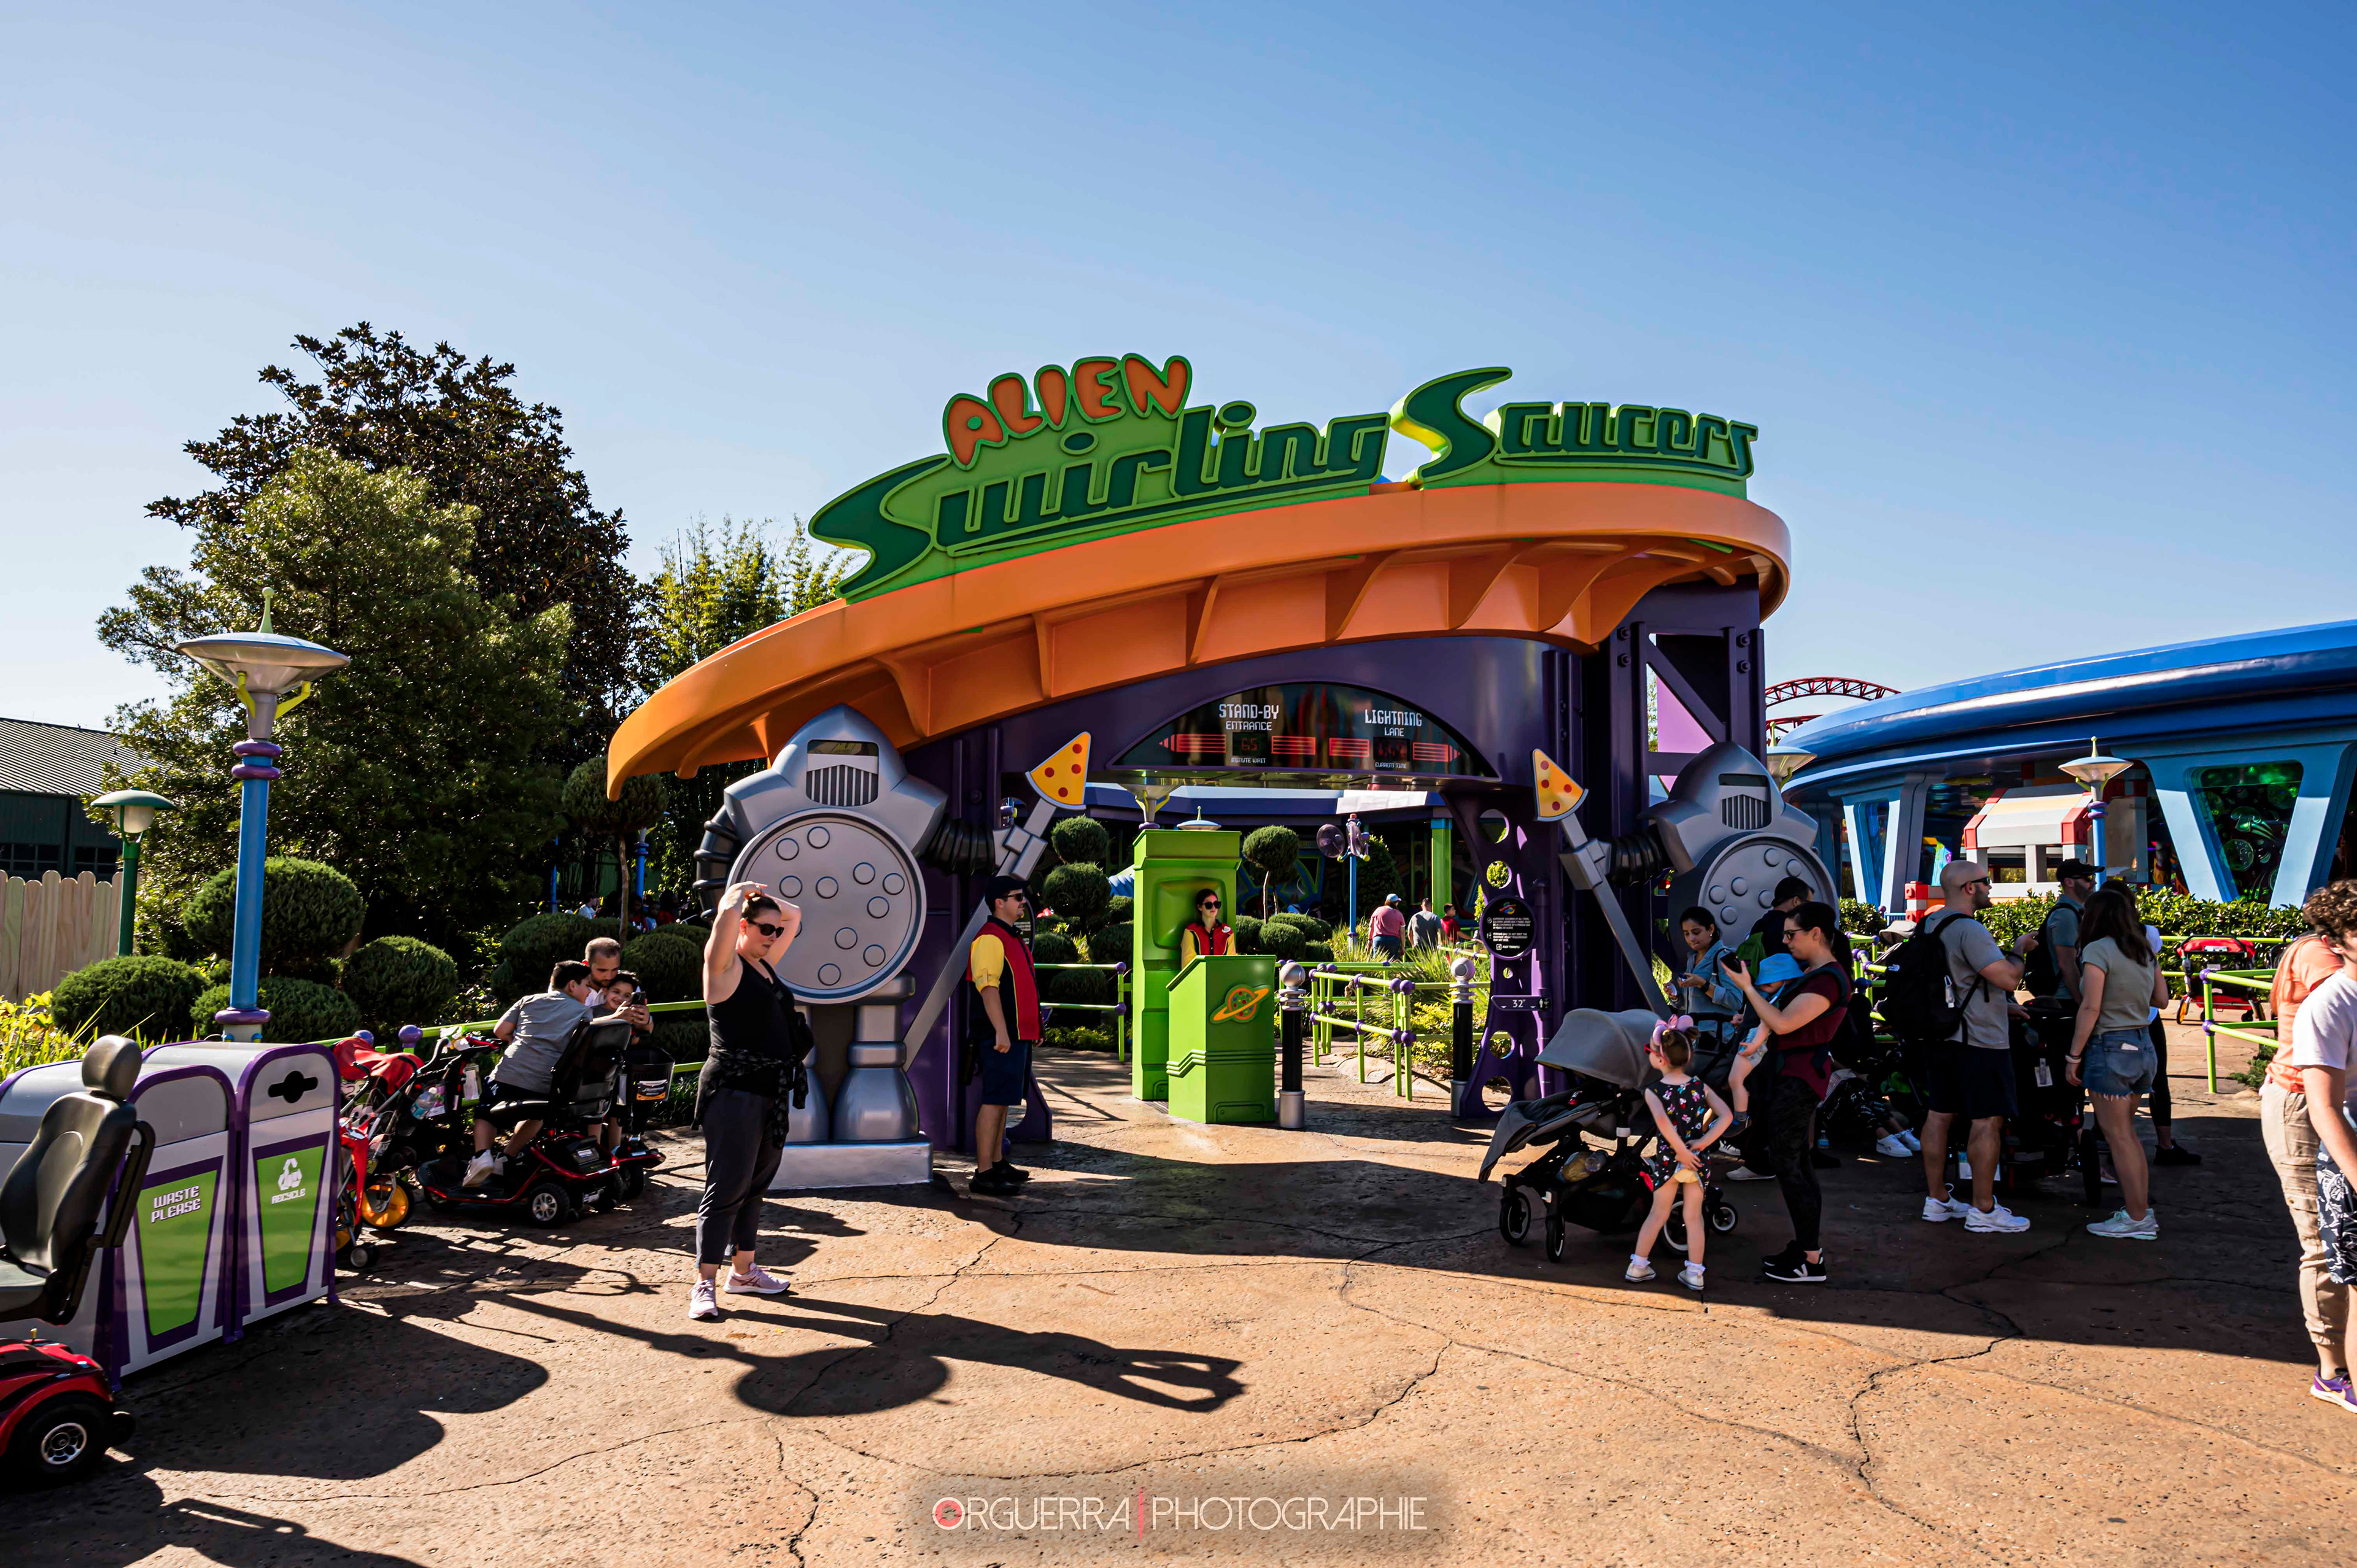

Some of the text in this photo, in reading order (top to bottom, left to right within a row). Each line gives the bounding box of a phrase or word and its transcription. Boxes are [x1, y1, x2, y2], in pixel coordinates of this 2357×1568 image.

[943, 353, 1192, 469] ALIEN
[1219, 704, 1279, 719] STAND-BY
[1364, 709, 1422, 727] LIGHTNING
[1226, 720, 1272, 731] ENTRANCE
[1384, 727, 1404, 736] LANE
[1241, 737, 1258, 751] 65
[153, 1185, 199, 1209] WASTE
[271, 1188, 306, 1204] RECYCLE
[150, 1198, 201, 1224] PLEASE
